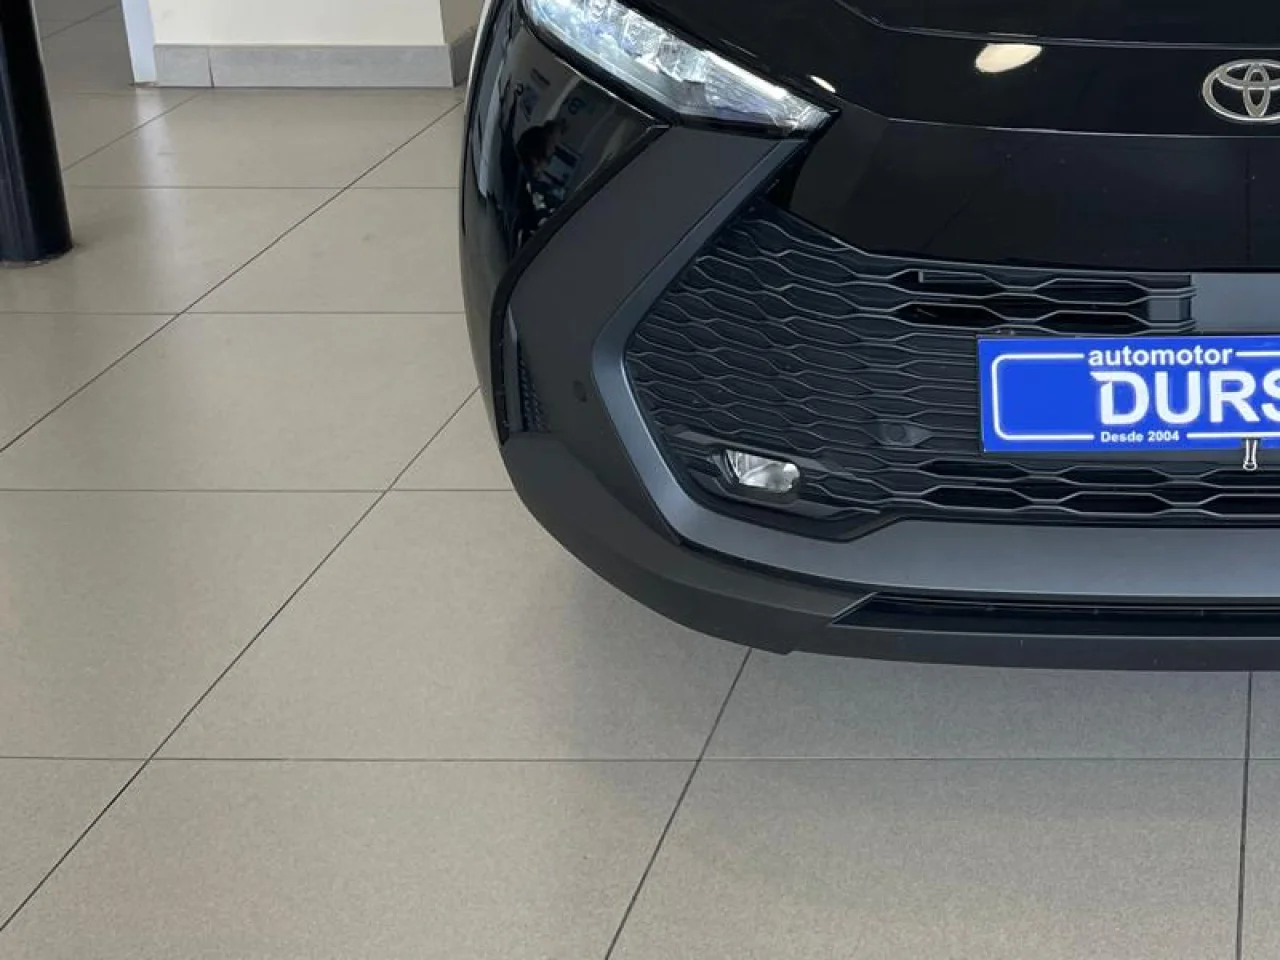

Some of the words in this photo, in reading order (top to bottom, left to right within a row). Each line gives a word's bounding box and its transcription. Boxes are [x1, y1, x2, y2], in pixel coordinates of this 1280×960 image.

[1088, 346, 1232, 366] automotor
[1100, 430, 1144, 443] Desde
[1147, 430, 1180, 442] 2004
